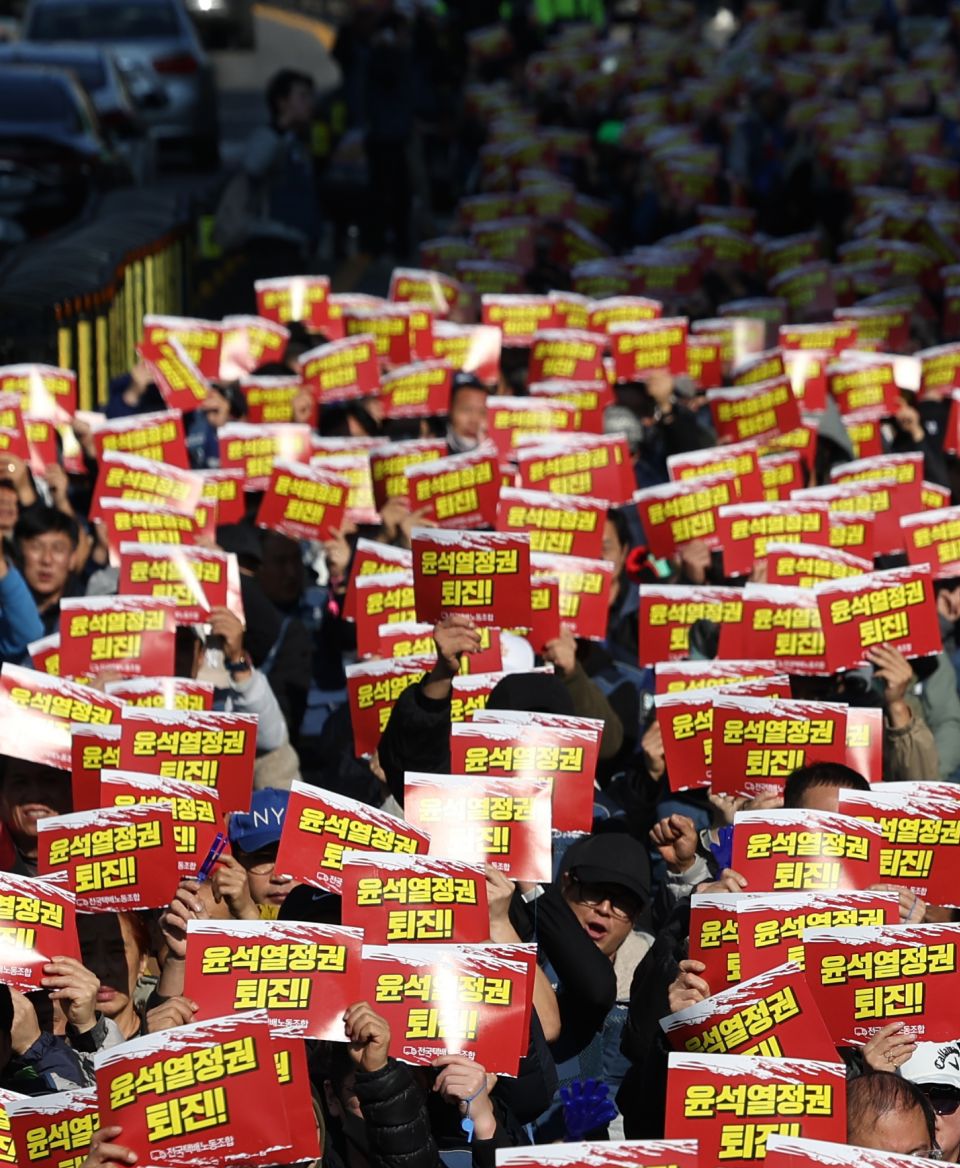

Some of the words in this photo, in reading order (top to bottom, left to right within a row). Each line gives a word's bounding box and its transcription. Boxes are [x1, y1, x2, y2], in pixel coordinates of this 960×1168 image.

[421, 549, 518, 575] 윤석열정권
[441, 579, 493, 607] 퇴진!
[830, 581, 925, 624] 윤석열정권
[69, 611, 166, 637] 윤석열정권
[649, 602, 743, 626] 윤석열정권
[775, 632, 826, 656] 퇴진!
[859, 612, 909, 647] 퇴진!
[90, 635, 142, 660] 퇴진!
[9, 687, 114, 726] 윤석열정권
[132, 730, 246, 756] 윤석열정권
[722, 719, 834, 745] 윤석열정권
[158, 760, 219, 788] 퇴진!
[464, 747, 585, 774] 윤석열정권
[745, 749, 805, 777] 퇴진!
[253, 807, 285, 828] NY
[298, 808, 419, 855] 윤석열정권
[48, 821, 162, 865] 윤석열정권
[746, 831, 869, 860] 윤석열정권
[74, 856, 136, 893] 퇴진!
[773, 862, 841, 891] 퇴진!
[878, 849, 934, 878] 퇴진!
[356, 876, 477, 906] 윤석열정권
[386, 909, 453, 940] 퇴진!
[201, 943, 347, 974] 윤석열정권
[820, 943, 955, 985] 윤석열정권
[233, 978, 311, 1009] 퇴진!
[854, 982, 924, 1020] 퇴진!
[109, 1037, 257, 1110] 윤석열정권
[145, 1087, 228, 1142] 퇴진!
[683, 1083, 832, 1117] 윤석열정권
[166, 1137, 234, 1158] 전국택배노동조합
